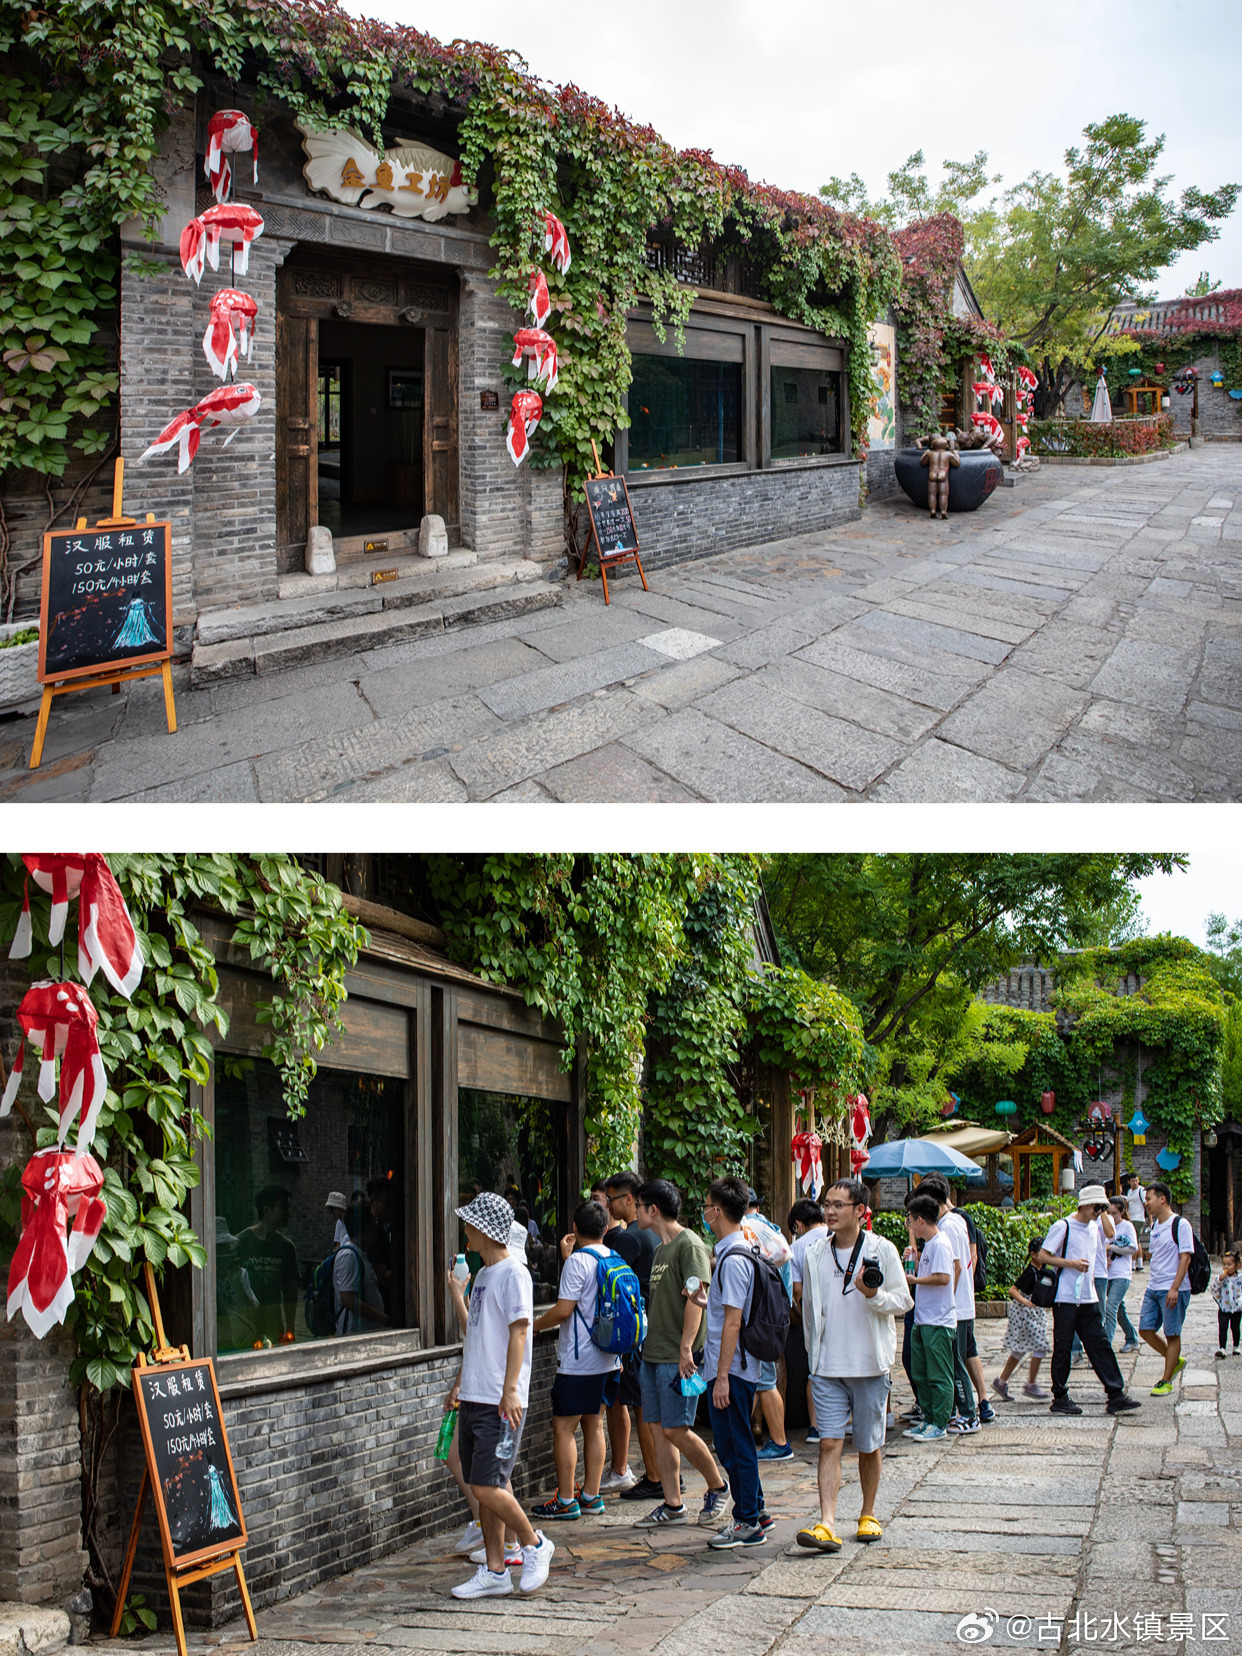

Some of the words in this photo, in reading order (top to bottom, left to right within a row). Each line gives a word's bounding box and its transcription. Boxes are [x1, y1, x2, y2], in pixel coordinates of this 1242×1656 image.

[341, 157, 452, 203] 金鱼工坊
[65, 529, 155, 554] 汉服租赁
[75, 552, 157, 575] 50元/小时/套
[149, 1369, 206, 1399] 汉服租赁
[163, 1401, 214, 1429] 50元/小时/套
